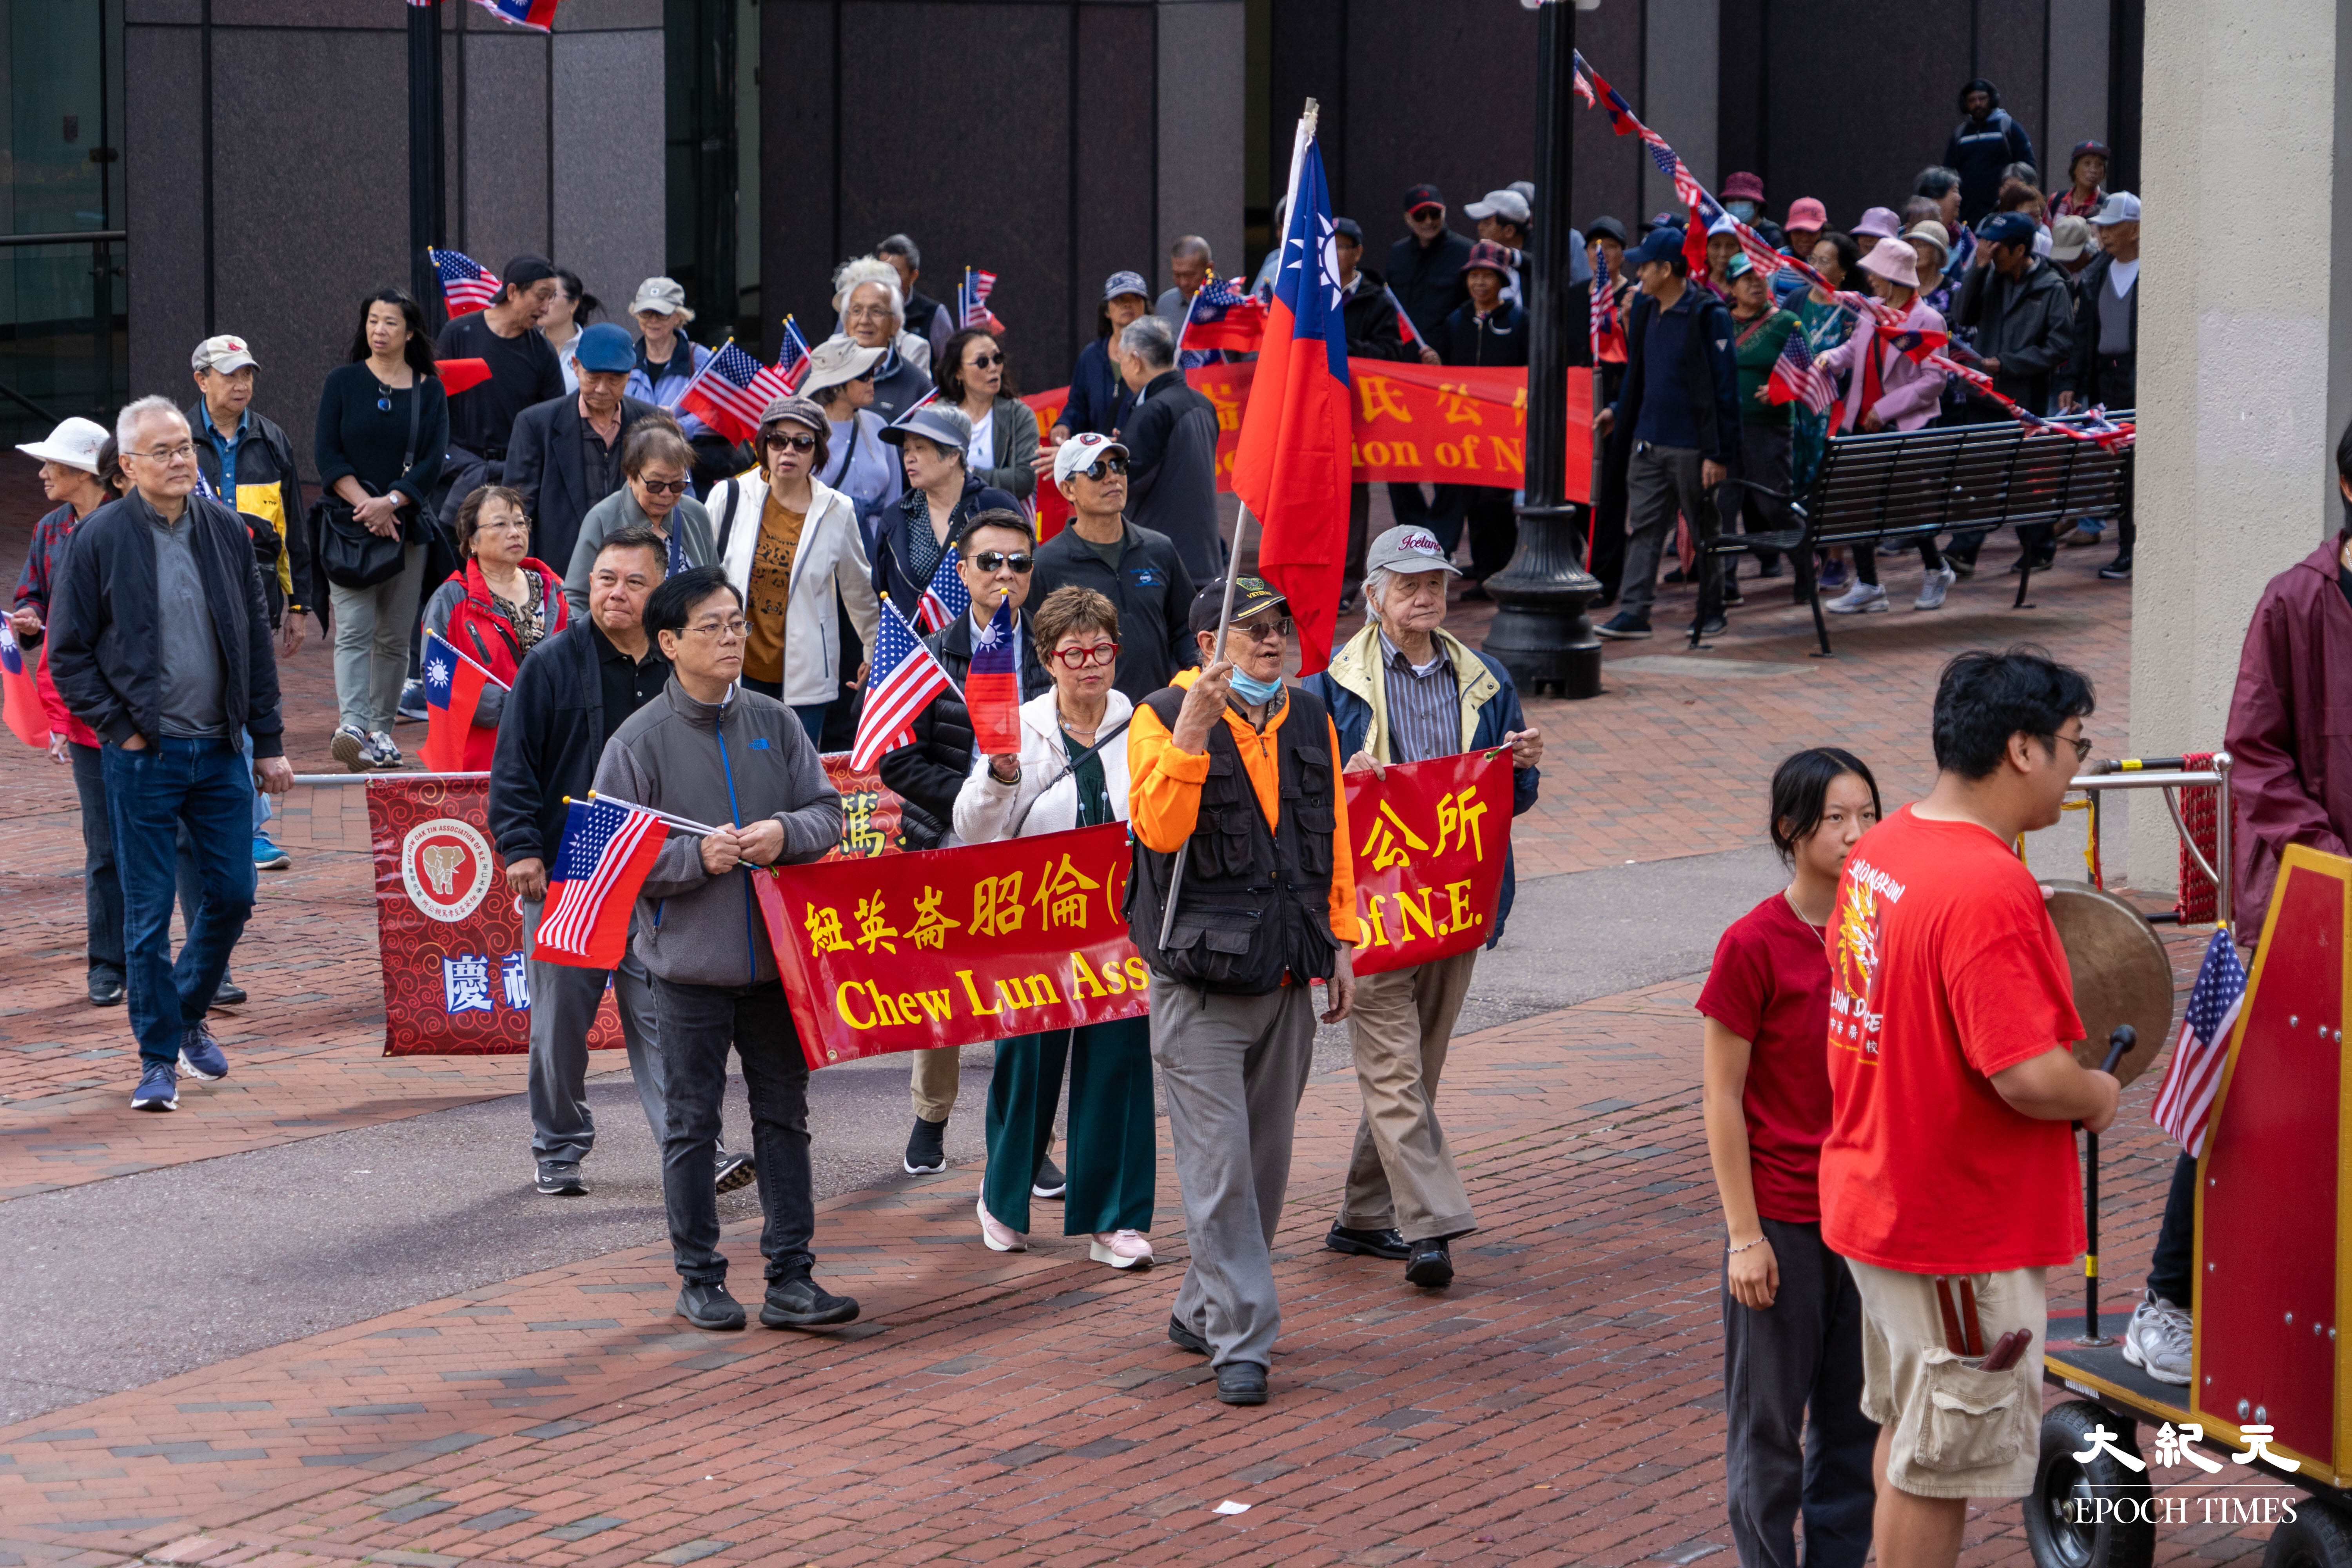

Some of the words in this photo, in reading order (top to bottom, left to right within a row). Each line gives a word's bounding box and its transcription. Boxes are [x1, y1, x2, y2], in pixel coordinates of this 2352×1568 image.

[1357, 376, 1528, 427] 氏公
[1435, 434, 1480, 468] of
[415, 830, 426, 840] OAK
[439, 825, 475, 843] ASSOCIATION
[804, 853, 1132, 957] 紐英崙昭倫(
[1360, 785, 1487, 872] 公所
[836, 979, 952, 1030] Chew
[955, 969, 1061, 1016] Lun
[1392, 878, 1483, 942] N.E.
[1831, 986, 1851, 1015] LION
